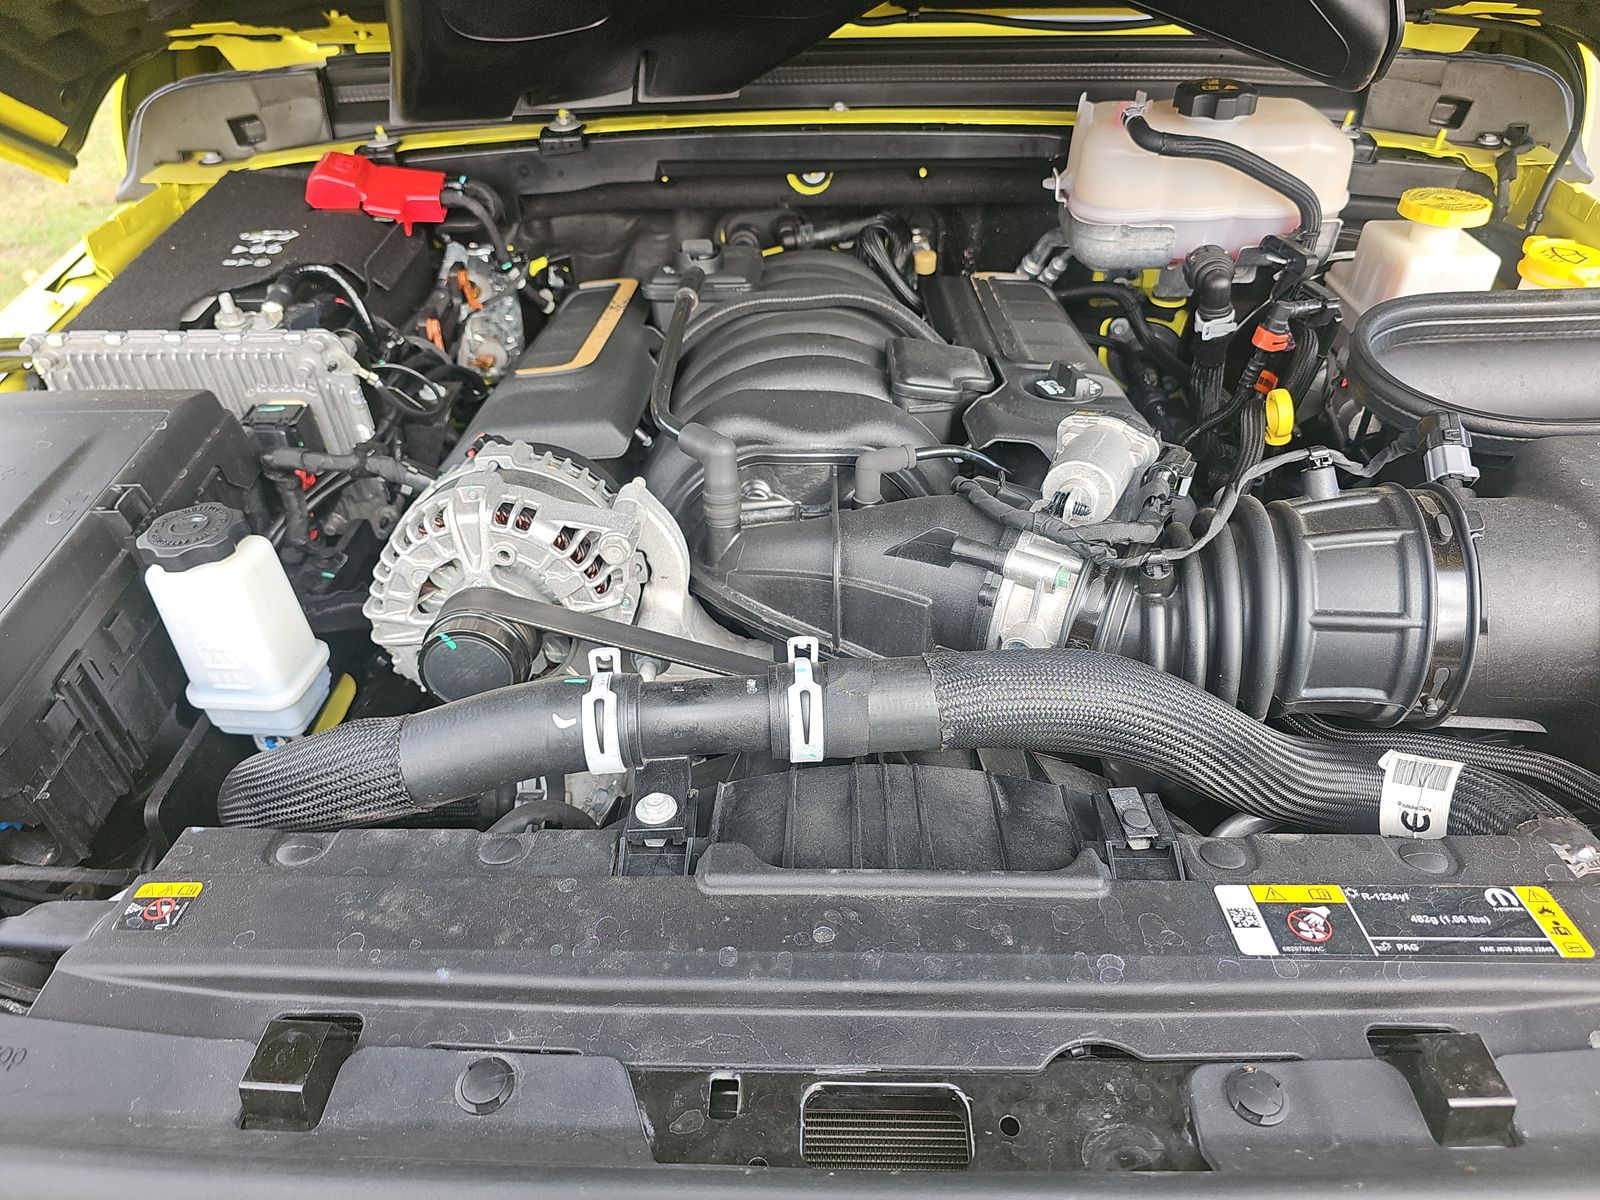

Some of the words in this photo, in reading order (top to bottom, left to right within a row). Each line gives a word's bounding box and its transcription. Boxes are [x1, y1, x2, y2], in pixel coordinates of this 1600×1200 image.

[1360, 892, 1410, 903] R-1234yf
[1410, 914, 1439, 925] 482g
[1396, 943, 1420, 952] PAG
